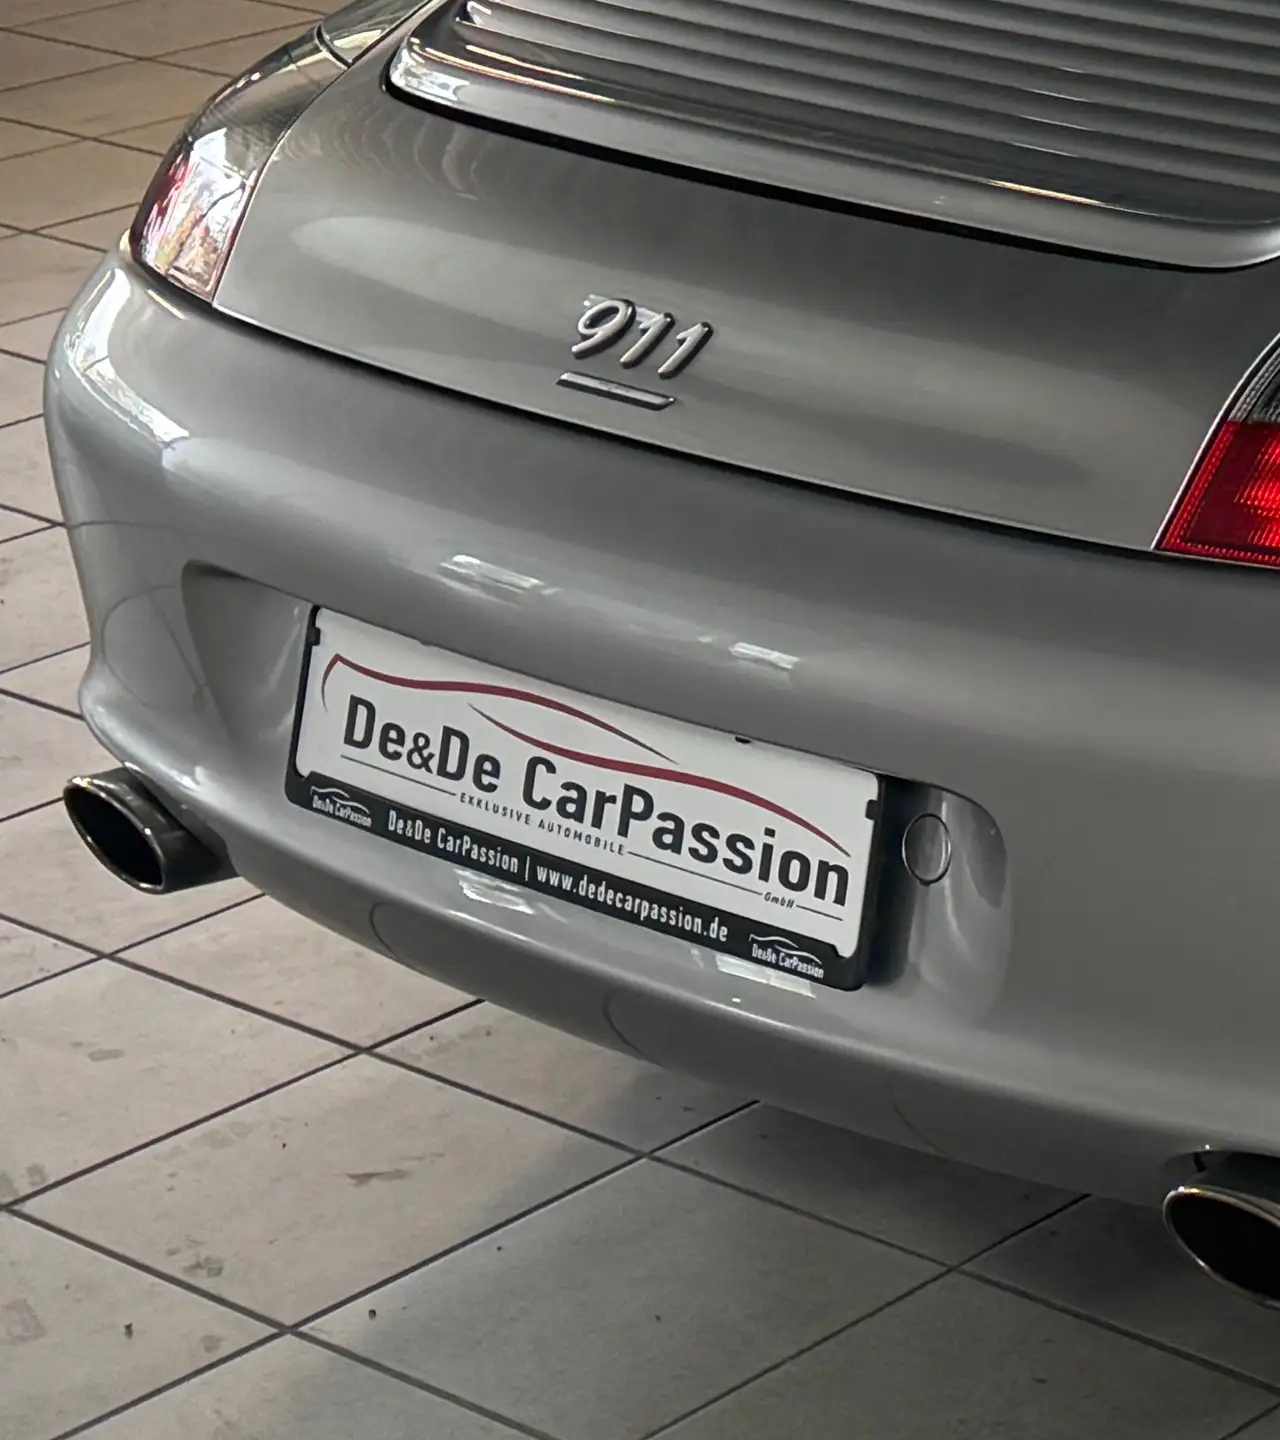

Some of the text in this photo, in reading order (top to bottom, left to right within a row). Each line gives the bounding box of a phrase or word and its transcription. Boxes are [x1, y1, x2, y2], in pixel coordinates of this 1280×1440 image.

[571, 298, 714, 380] 911
[342, 694, 850, 907] De&De CarPassion
[459, 792, 626, 856] EXKLUSIVE AUTOMOBILE
[387, 809, 432, 844] De&De
[436, 827, 520, 874] CarPassion
[536, 864, 729, 942] www.dedecarpassion.de
[763, 891, 796, 909] GmbH
